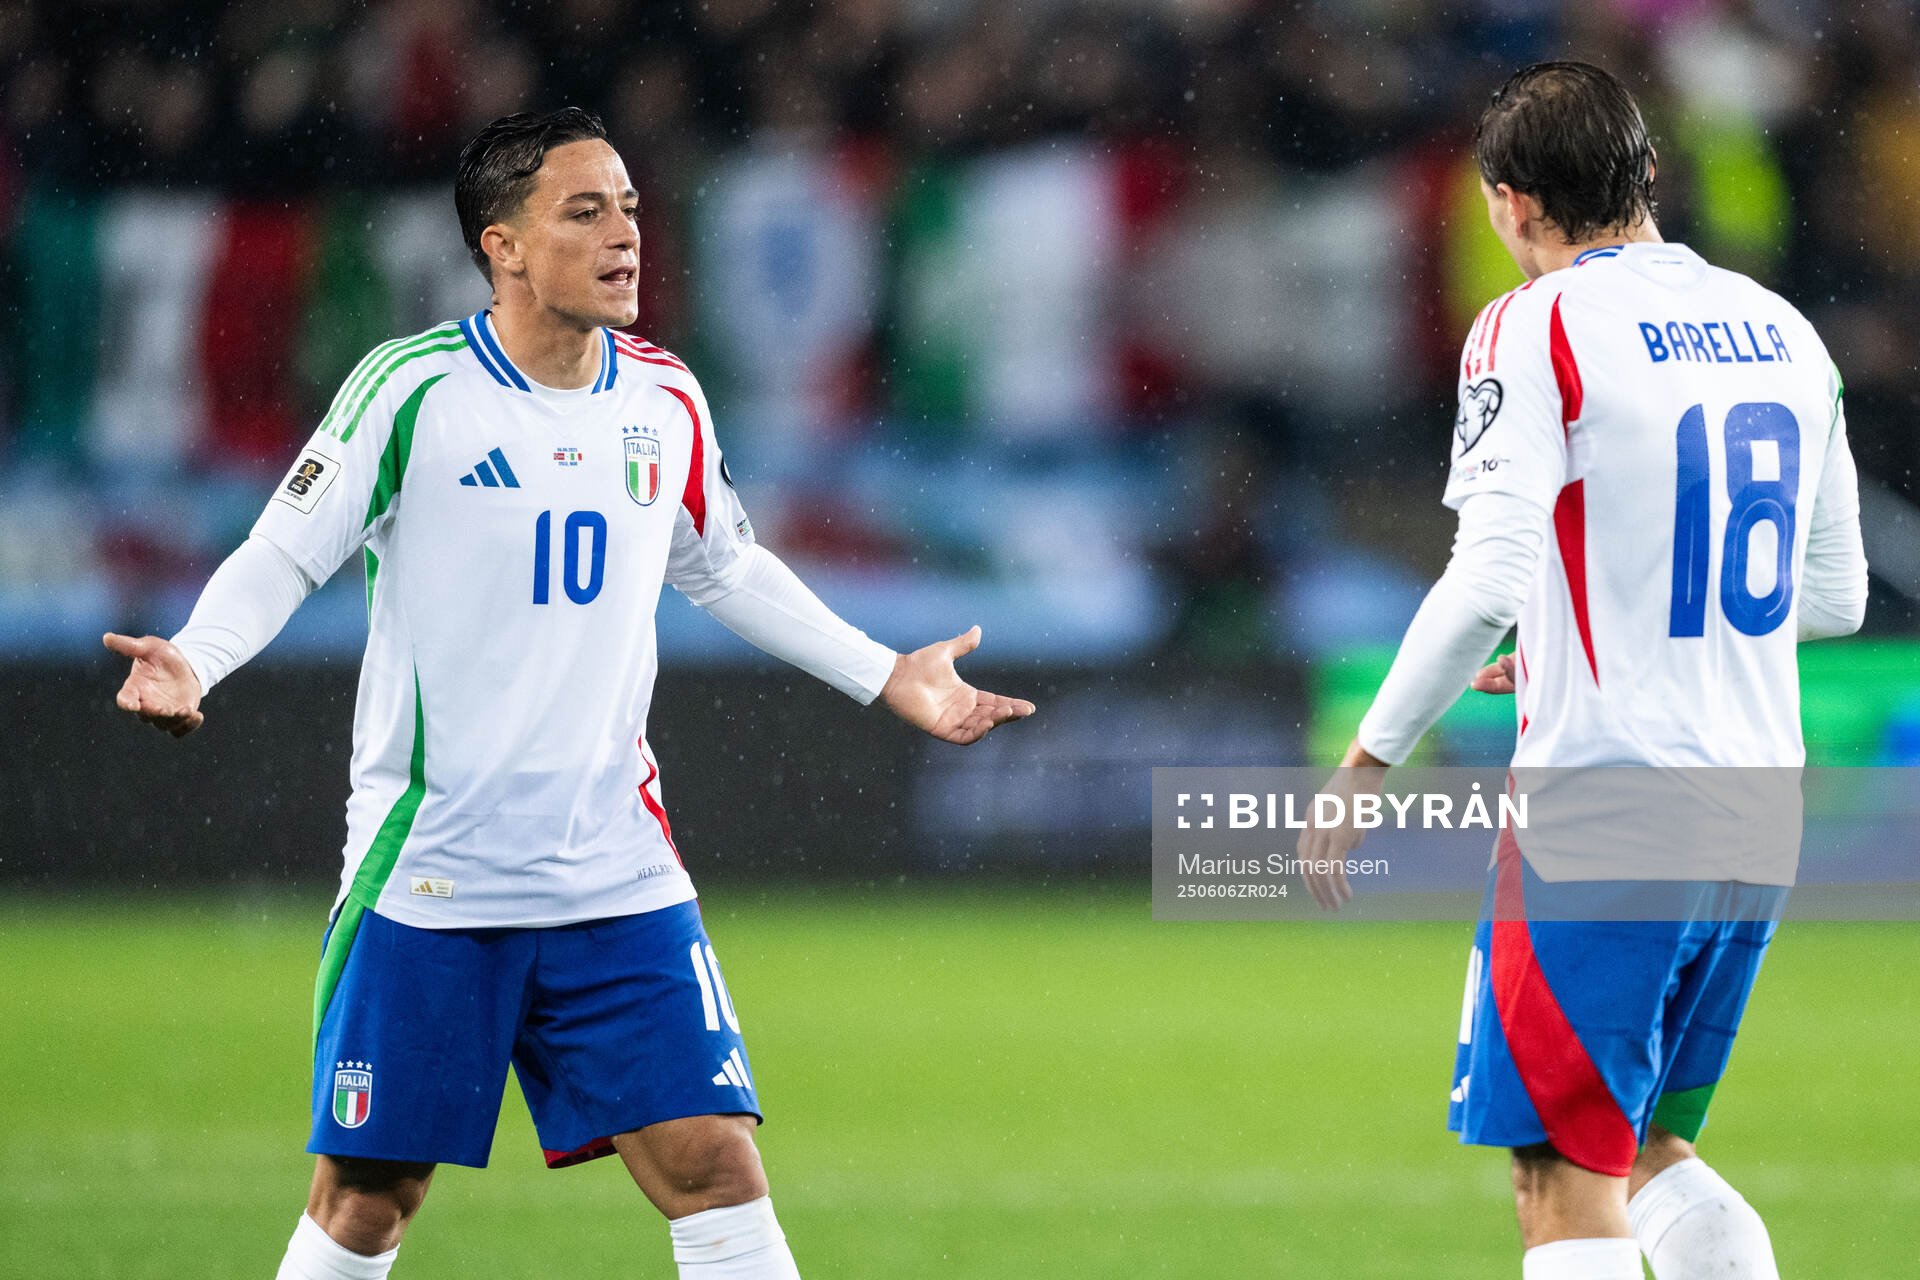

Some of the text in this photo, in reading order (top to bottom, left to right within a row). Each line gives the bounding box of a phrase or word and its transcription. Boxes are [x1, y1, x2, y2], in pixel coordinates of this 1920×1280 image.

[1638, 321, 1792, 363] BARELLA
[627, 441, 658, 457] ITALIA
[1669, 402, 1800, 638] 18
[533, 509, 608, 606] 10
[338, 1074, 369, 1088] ITALIA
